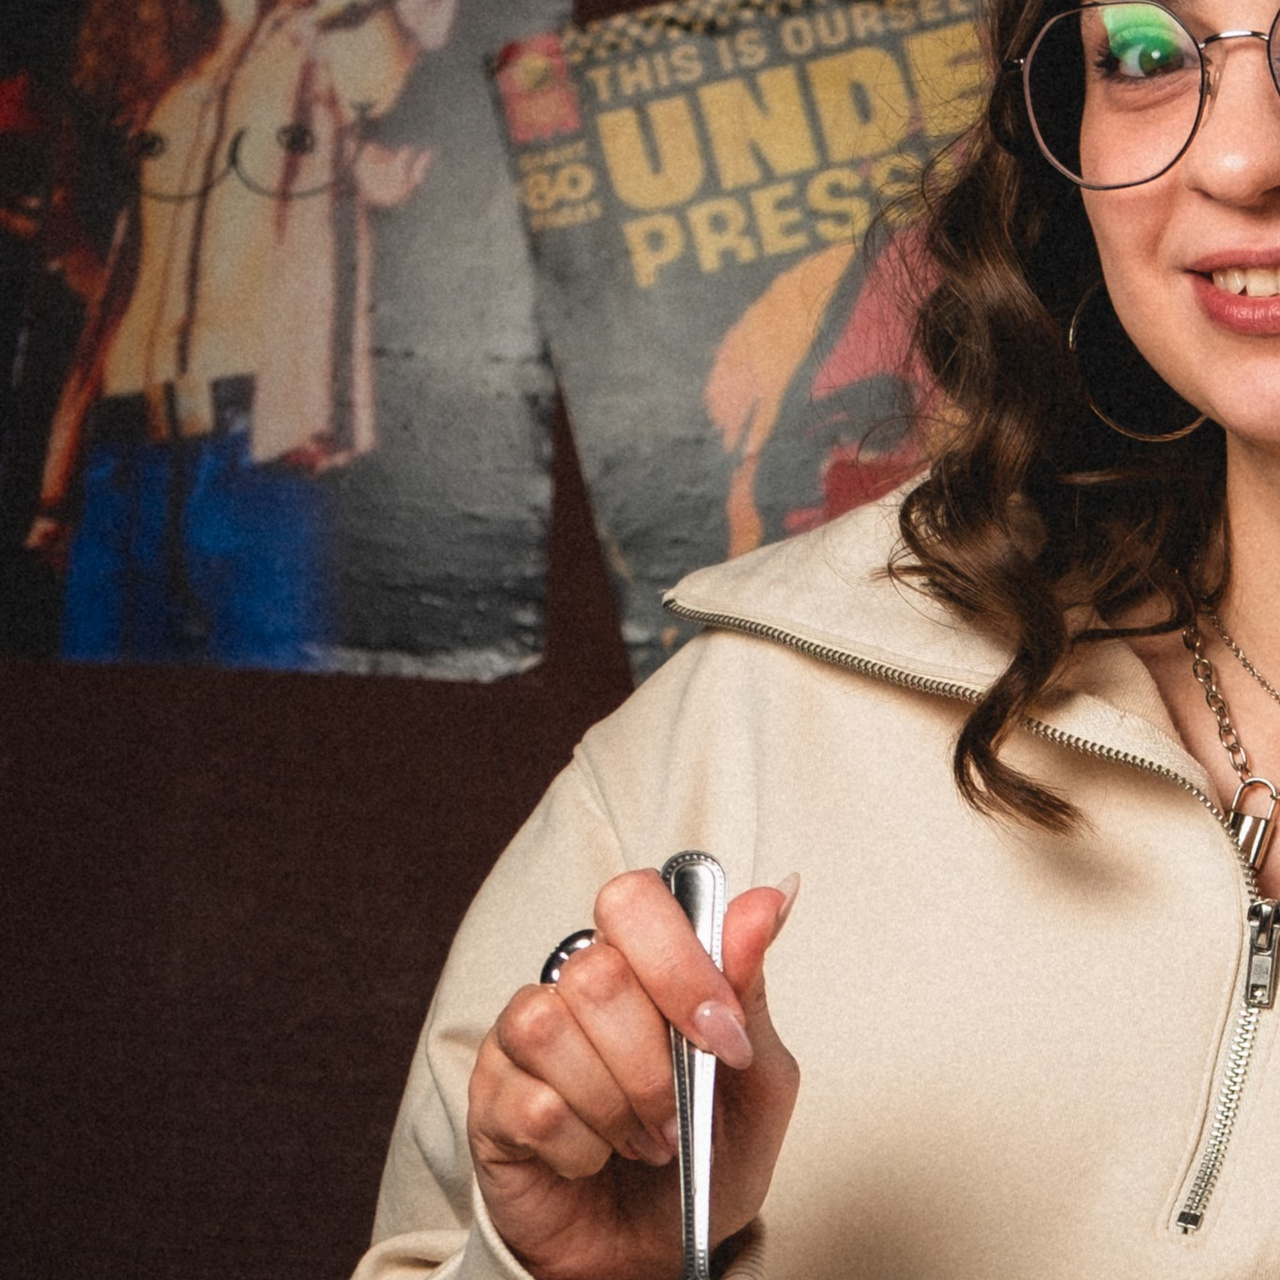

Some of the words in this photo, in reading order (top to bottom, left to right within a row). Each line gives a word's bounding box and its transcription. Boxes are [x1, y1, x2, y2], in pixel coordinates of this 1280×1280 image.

[587, 41, 702, 104] THIS
[716, 28, 768, 71] IS
[597, 22, 994, 212] UNDE
[521, 163, 596, 210] 80
[622, 145, 945, 290] PRESS
